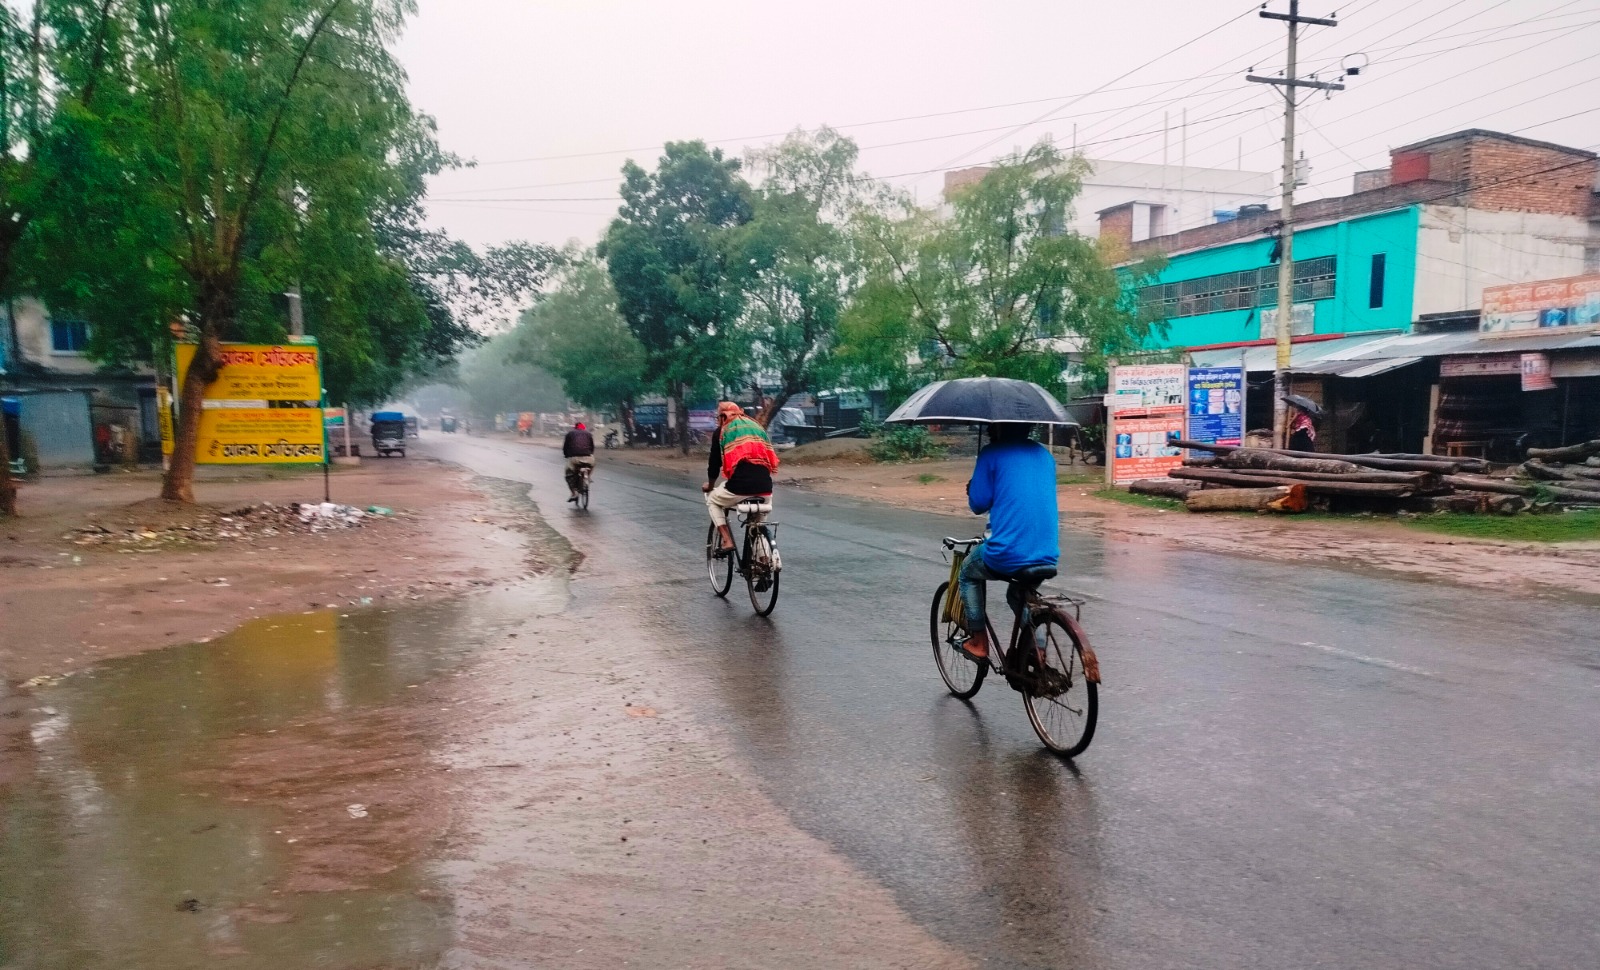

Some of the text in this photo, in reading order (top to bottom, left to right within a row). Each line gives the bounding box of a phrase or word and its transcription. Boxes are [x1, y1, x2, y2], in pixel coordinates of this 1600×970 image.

[220, 346, 318, 367] আলম মেডিকেল
[223, 438, 322, 457] আলম মেডিকেল
